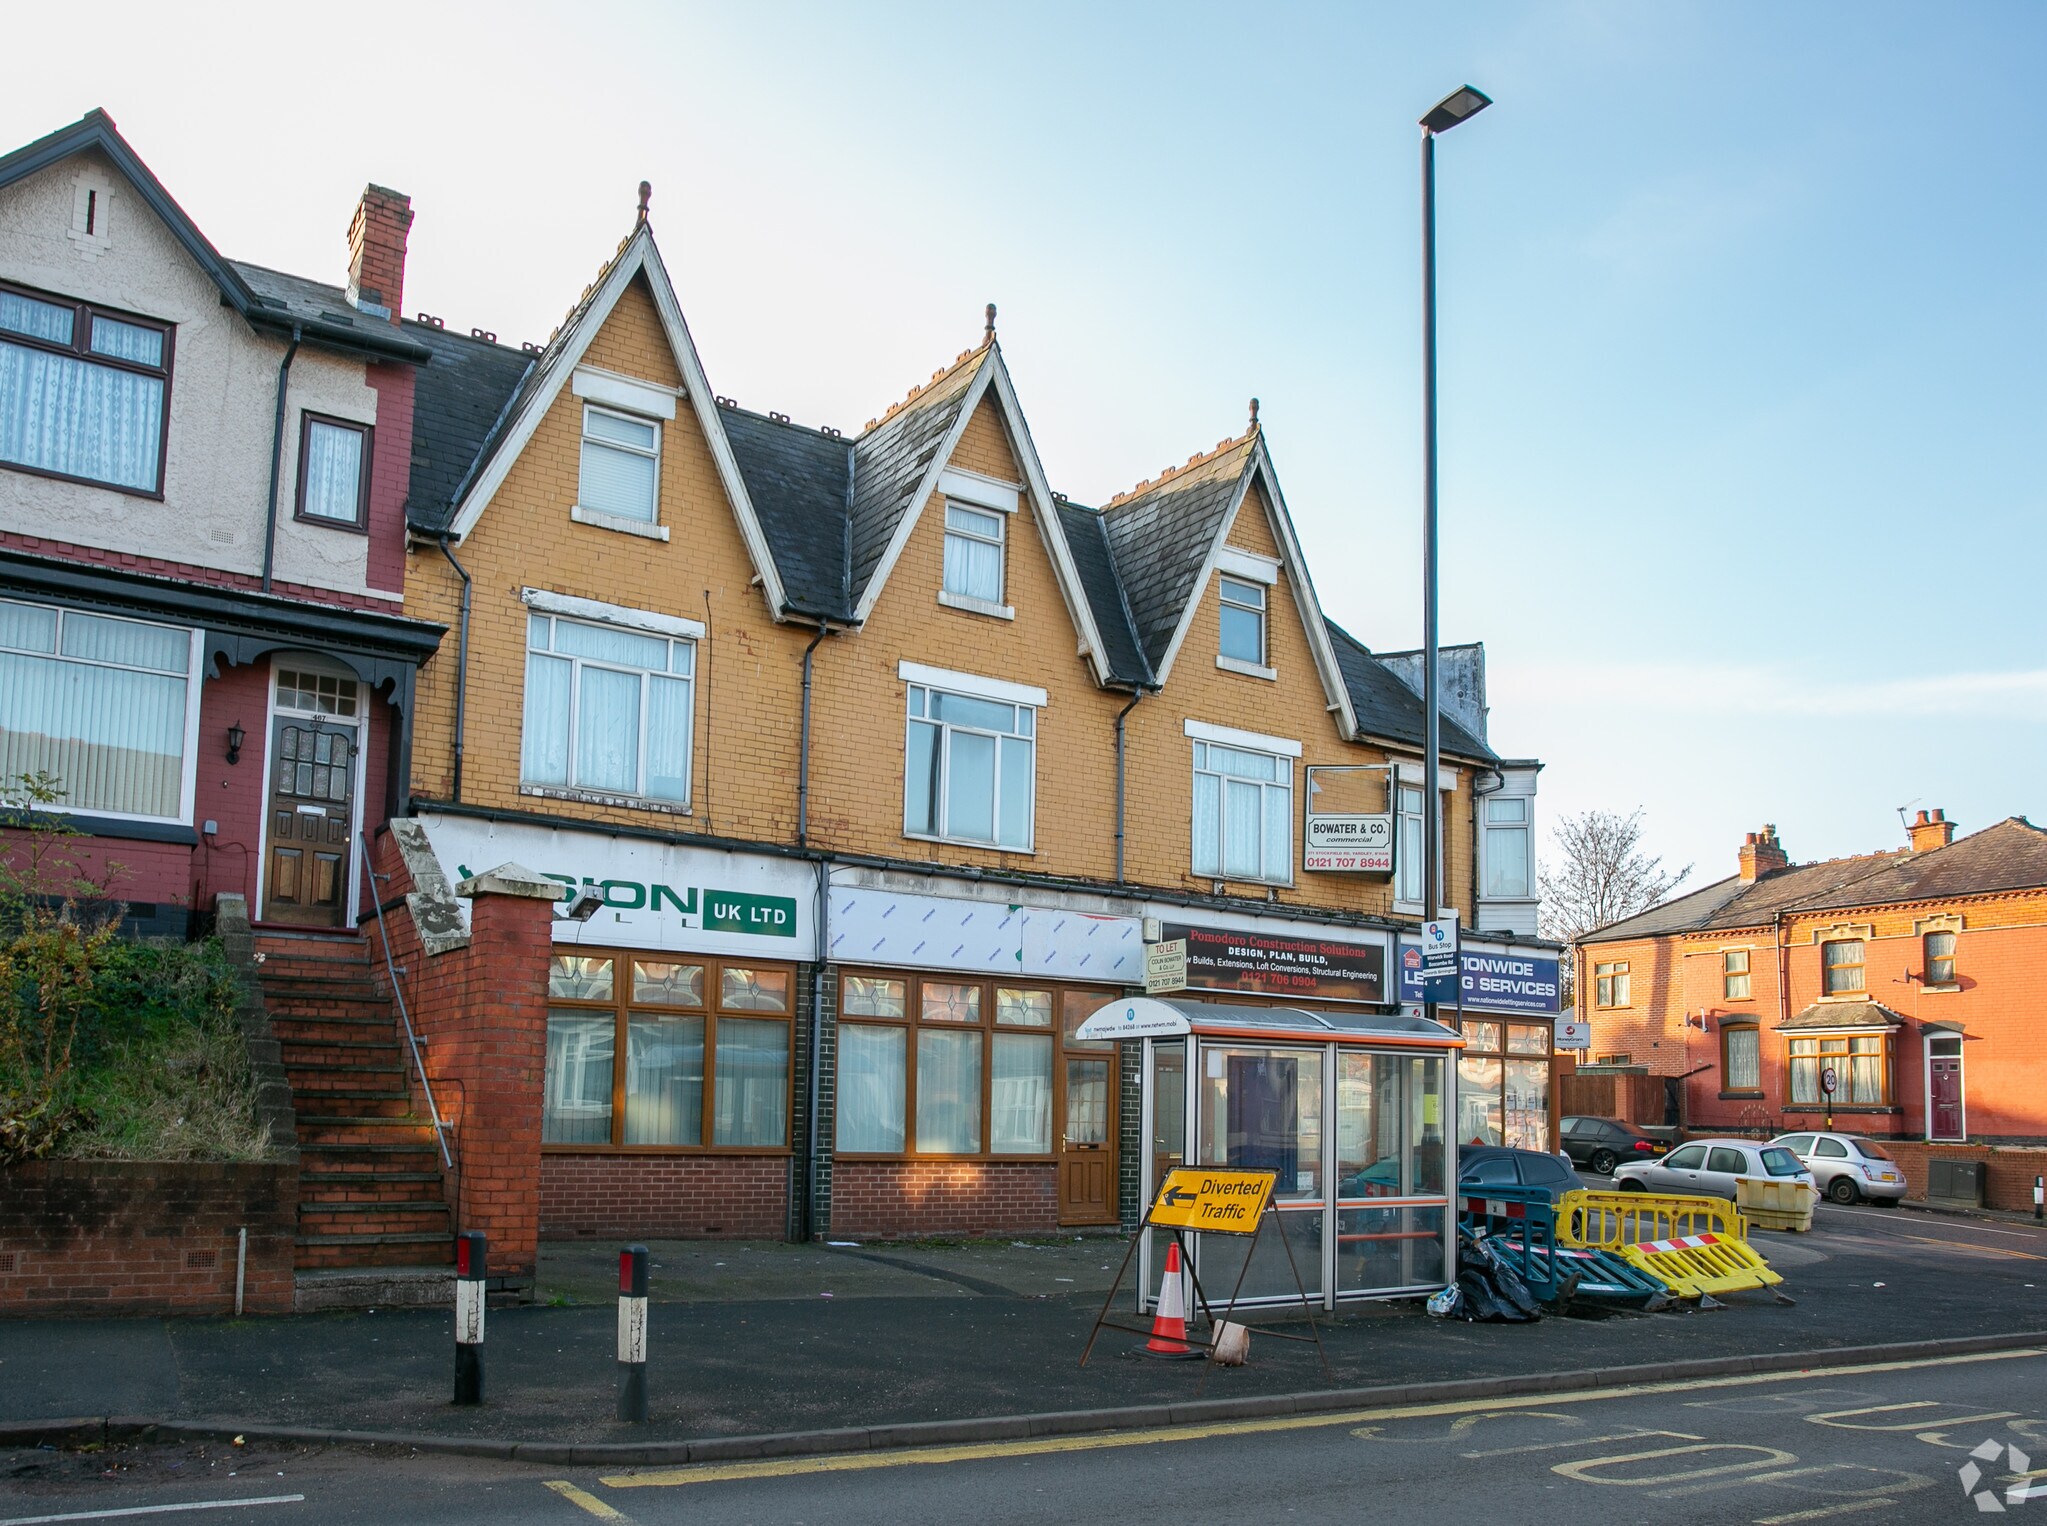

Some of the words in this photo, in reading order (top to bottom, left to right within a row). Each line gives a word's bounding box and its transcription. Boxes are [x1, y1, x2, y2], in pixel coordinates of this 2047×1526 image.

[1313, 824, 1357, 834] BOWATER
[1360, 824, 1366, 834] &
[1370, 824, 1386, 834] CO.
[1307, 857, 1332, 867] 0121
[1336, 857, 1356, 867] 707
[1360, 857, 1390, 868] 8944
[714, 903, 742, 920] UK
[750, 907, 787, 925] LTD
[1155, 944, 1165, 954] TO
[1165, 942, 1178, 953] LET
[1190, 929, 1246, 946] Pomodoro
[1249, 936, 1317, 952] Construction
[1320, 943, 1367, 958] Solutions
[1228, 946, 1266, 959] DESIGN,
[1269, 951, 1296, 963] PLAN,
[1299, 953, 1328, 965] BUILD,
[1193, 955, 1216, 967] Builds,
[1217, 958, 1255, 970] Extensions,
[1256, 962, 1270, 971] Loft
[1270, 964, 1311, 975] Conversions,
[1312, 966, 1342, 977] Structural
[1342, 970, 1378, 982] Engineering
[1148, 979, 1160, 988] 0121
[1161, 978, 1171, 986] 707
[1241, 971, 1267, 983] 0121
[1270, 974, 1289, 985] 706
[1479, 977, 1556, 997] SERVICES
[1467, 996, 1547, 1008] www.nationwidelettingservices.com
[1826, 1074, 1835, 1085] 20
[1200, 1179, 1264, 1195] Diverted
[1201, 1202, 1246, 1219] Traffic
